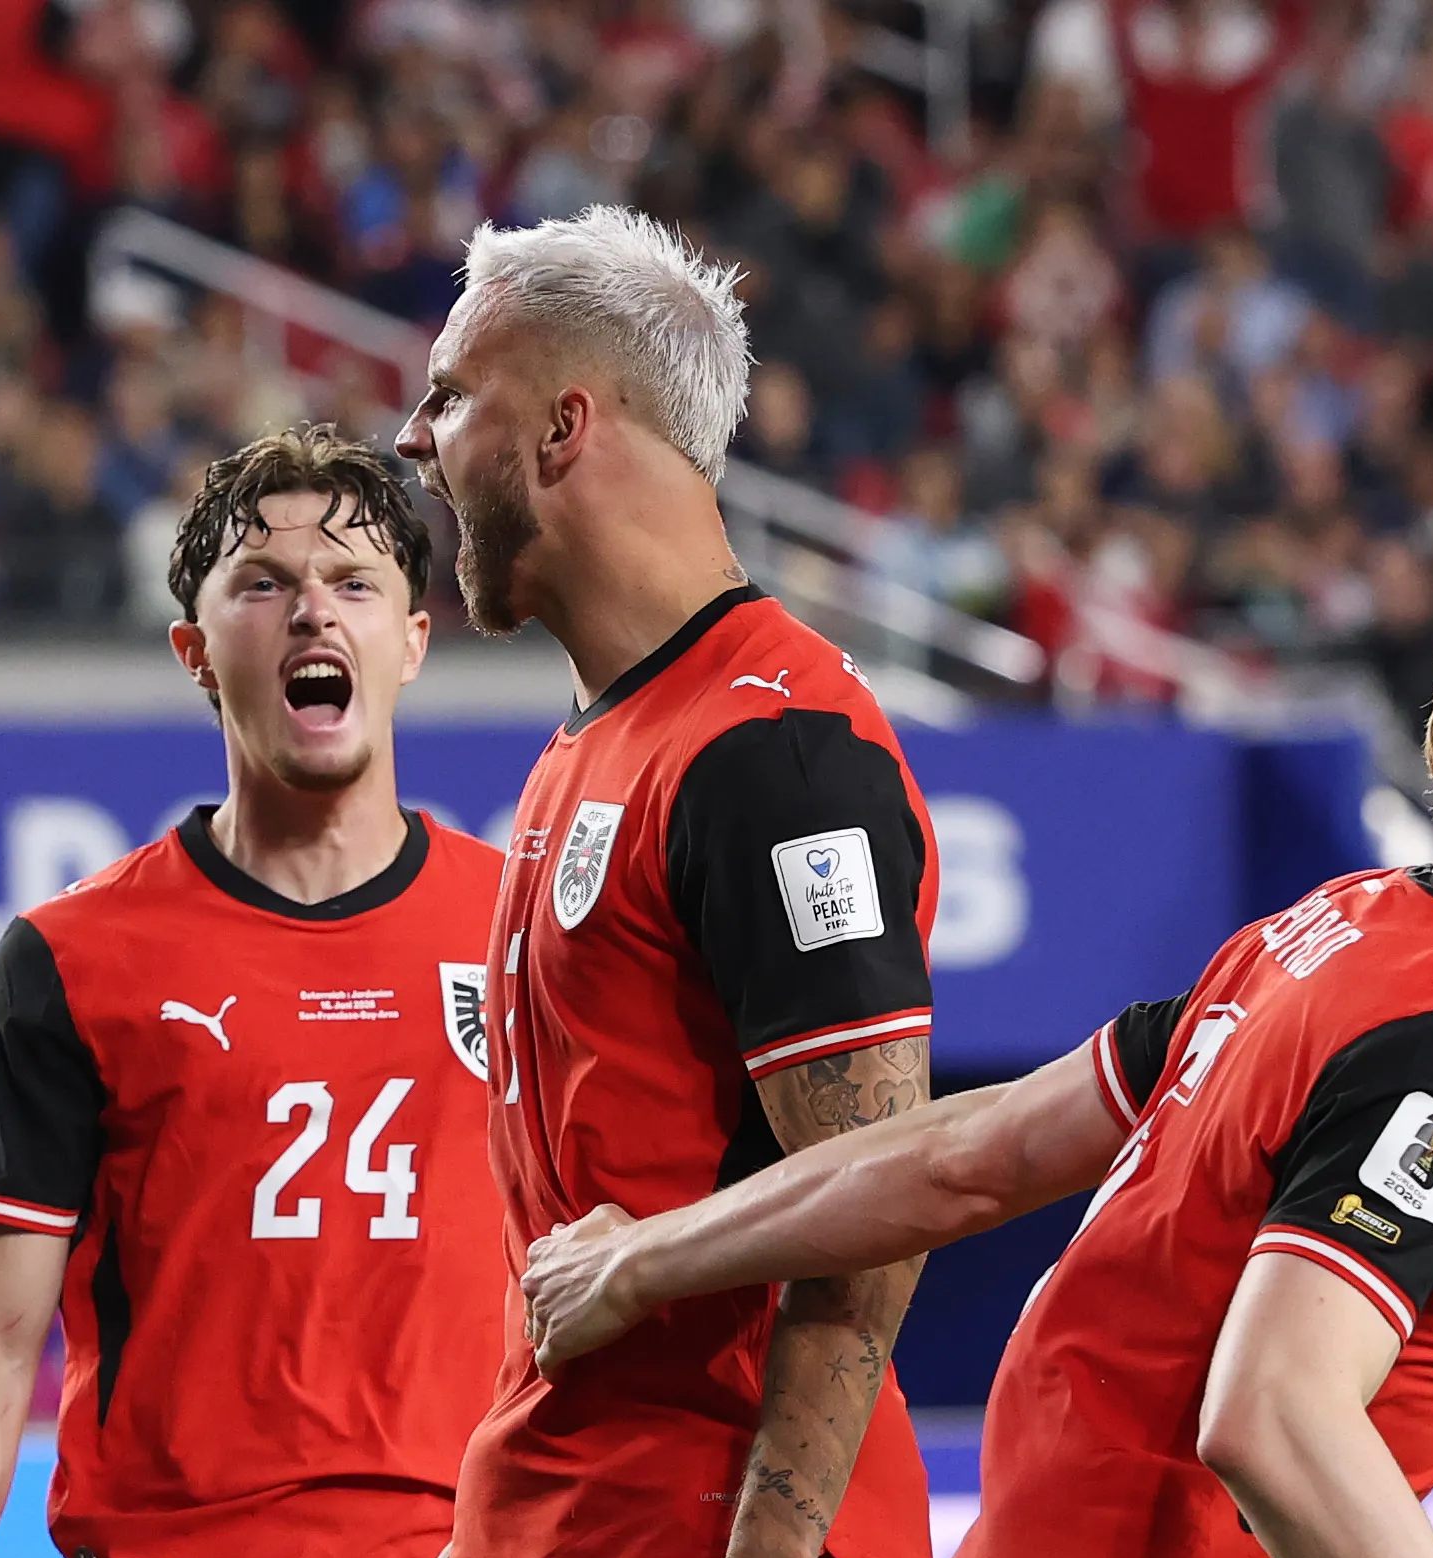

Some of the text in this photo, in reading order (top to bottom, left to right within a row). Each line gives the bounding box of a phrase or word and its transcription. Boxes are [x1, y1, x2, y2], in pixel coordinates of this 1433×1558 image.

[806, 878, 854, 903] Unite For
[812, 897, 856, 922] PEACE
[825, 919, 849, 931] FIFA
[252, 1078, 419, 1239] 24
[1390, 1170, 1415, 1191] WORLD
[1408, 1162, 1428, 1183] FIFA
[1383, 1177, 1423, 1210] 2026
[1352, 1208, 1396, 1235] DEBUT
